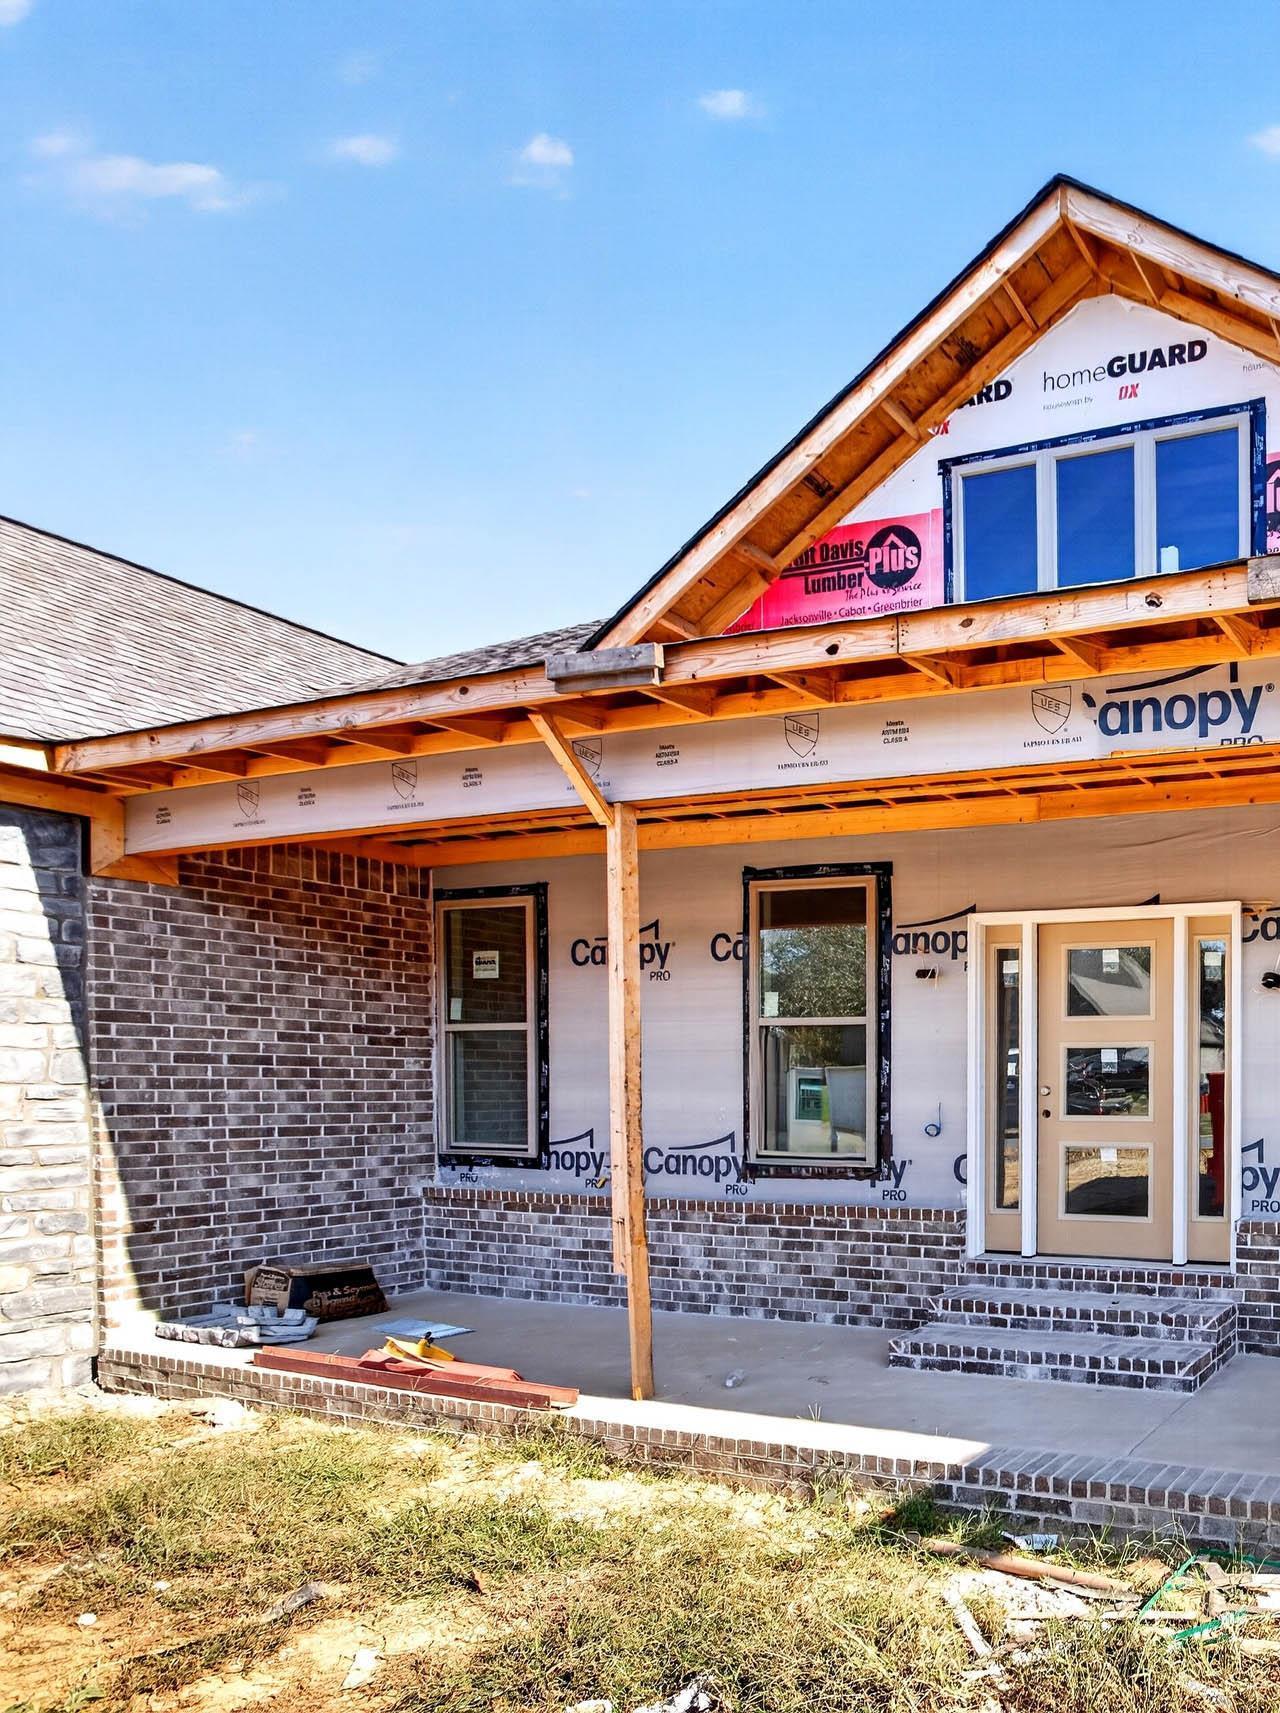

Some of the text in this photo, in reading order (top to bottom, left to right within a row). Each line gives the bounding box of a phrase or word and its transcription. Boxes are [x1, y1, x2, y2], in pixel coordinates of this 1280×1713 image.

[1043, 339, 1208, 392] homeGUARD
[819, 538, 864, 563] Davis
[868, 545, 920, 576] Plus
[804, 570, 864, 595] Lumber
[845, 588, 858, 602] The
[860, 586, 879, 600] Plus
[780, 597, 923, 626] Jacksonville Cabot Greenbrier
[1040, 697, 1061, 712] UES
[1082, 685, 1264, 738] anopy
[791, 723, 810, 738] UES
[570, 937, 671, 970] Capy
[649, 970, 671, 981] PRO
[725, 1184, 748, 1195] PRO
[882, 1189, 907, 1201] PRO
[1251, 1199, 1280, 1213] PRO
